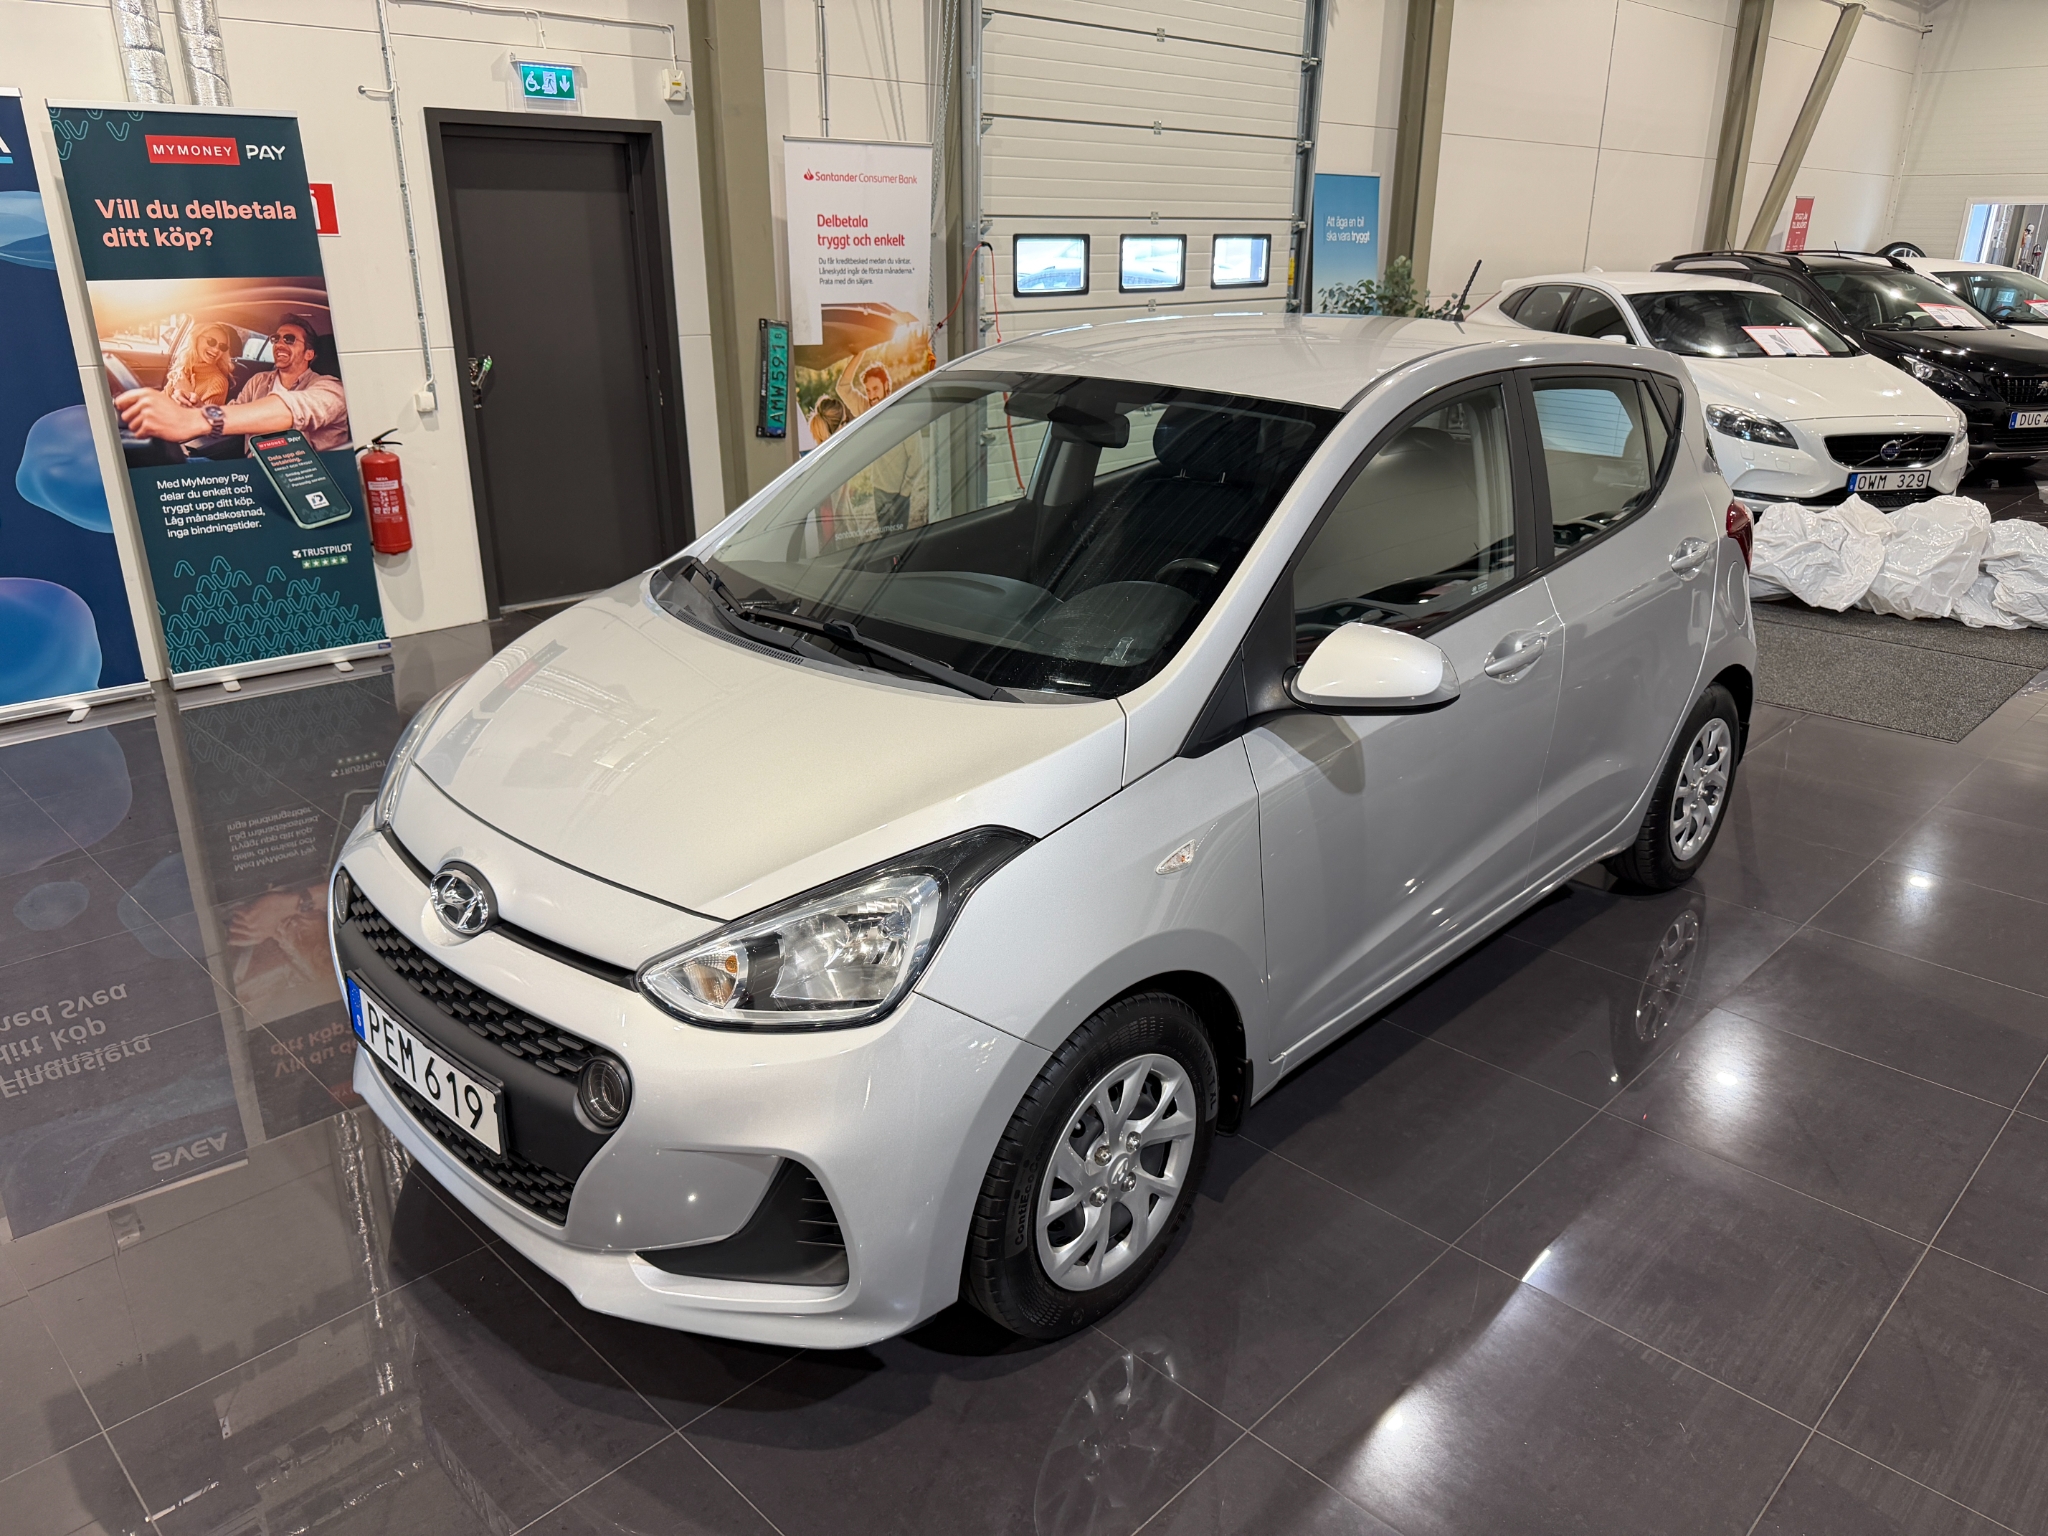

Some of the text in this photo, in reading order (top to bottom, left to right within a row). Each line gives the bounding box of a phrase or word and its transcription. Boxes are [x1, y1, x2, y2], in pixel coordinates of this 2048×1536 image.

[152, 144, 286, 161] MYMONEY PAY
[815, 172, 917, 184] Santander Consumer Bank
[95, 199, 297, 220] Vill du delbetala
[817, 214, 868, 227] Delbetala
[1326, 216, 1335, 227] Att
[1336, 216, 1348, 229] äga
[1349, 218, 1356, 227] en
[102, 226, 214, 250] ditt köp?
[818, 234, 905, 250] tryggt och enkelt
[1326, 230, 1370, 243] ska vara tryggt
[2020, 414, 2041, 426] DUG
[157, 474, 249, 489] Med MyMoney Pay
[1858, 474, 1925, 489] OWM 329
[160, 485, 252, 501] delar du enkelt och
[162, 497, 255, 514] tryggt upp ditt köp.
[165, 507, 265, 526] Låg månadskostnad,
[167, 520, 261, 538] inga bindningstider.
[302, 543, 352, 557] TRUSTPILOT
[368, 1004, 483, 1130] PEM 619
